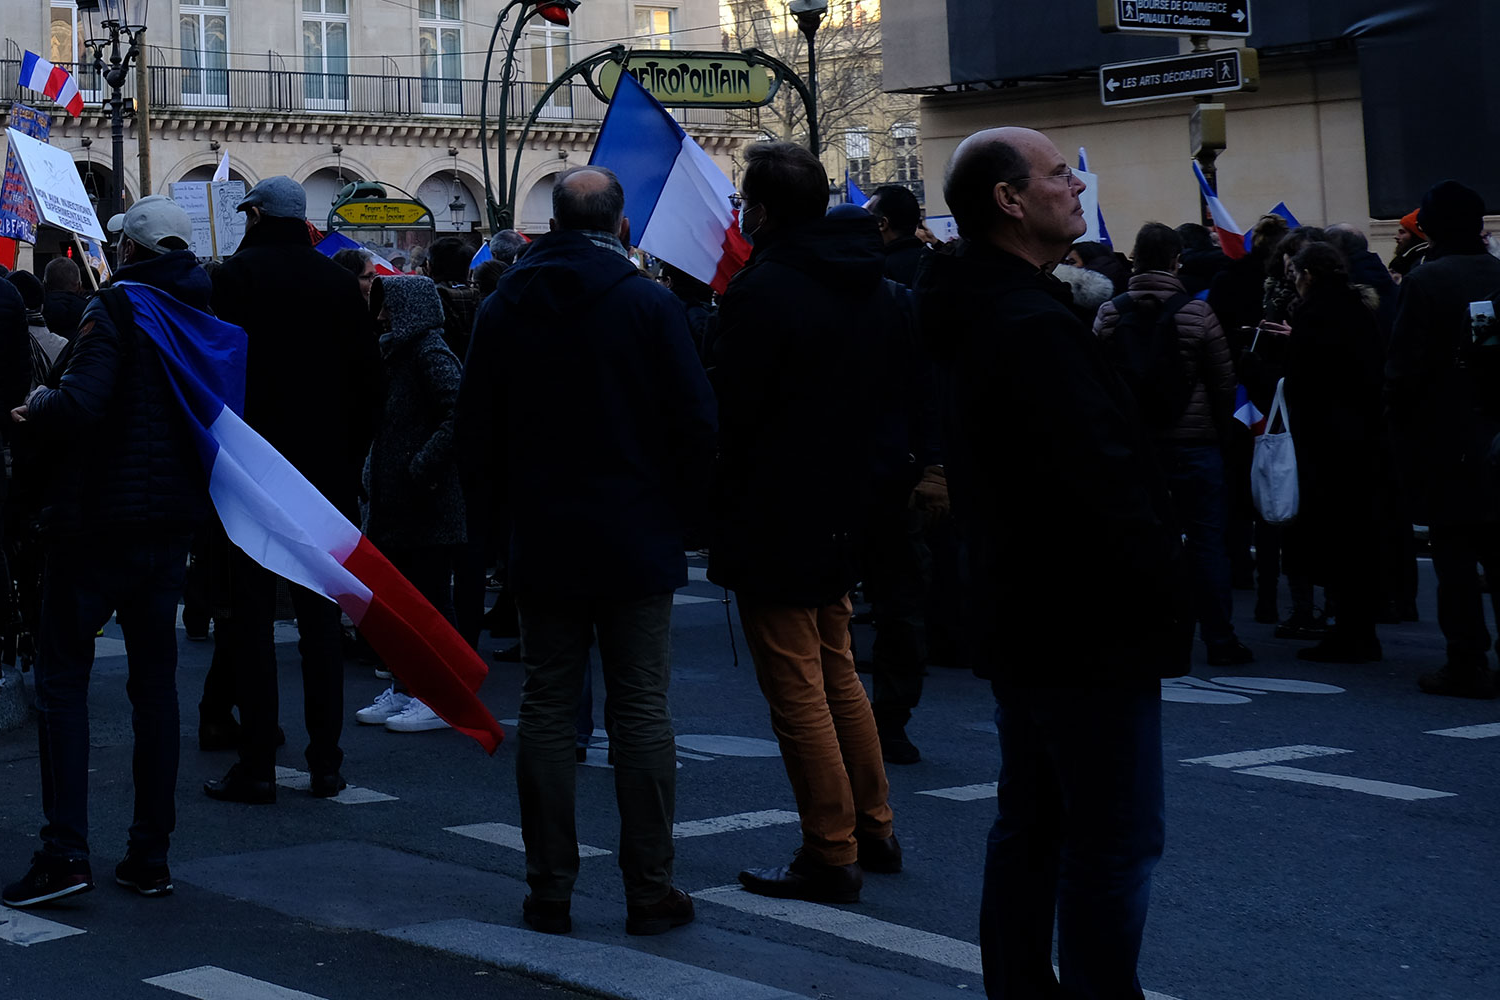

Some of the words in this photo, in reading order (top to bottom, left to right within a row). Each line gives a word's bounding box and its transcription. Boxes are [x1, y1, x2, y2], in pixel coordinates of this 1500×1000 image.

[1170, 0, 1182, 11] DE
[1182, 1, 1228, 13] COMMERCE
[1138, 13, 1172, 25] PINAULT
[1173, 14, 1211, 27] Collection
[1122, 77, 1137, 89] LES
[1138, 74, 1161, 87] ARTS
